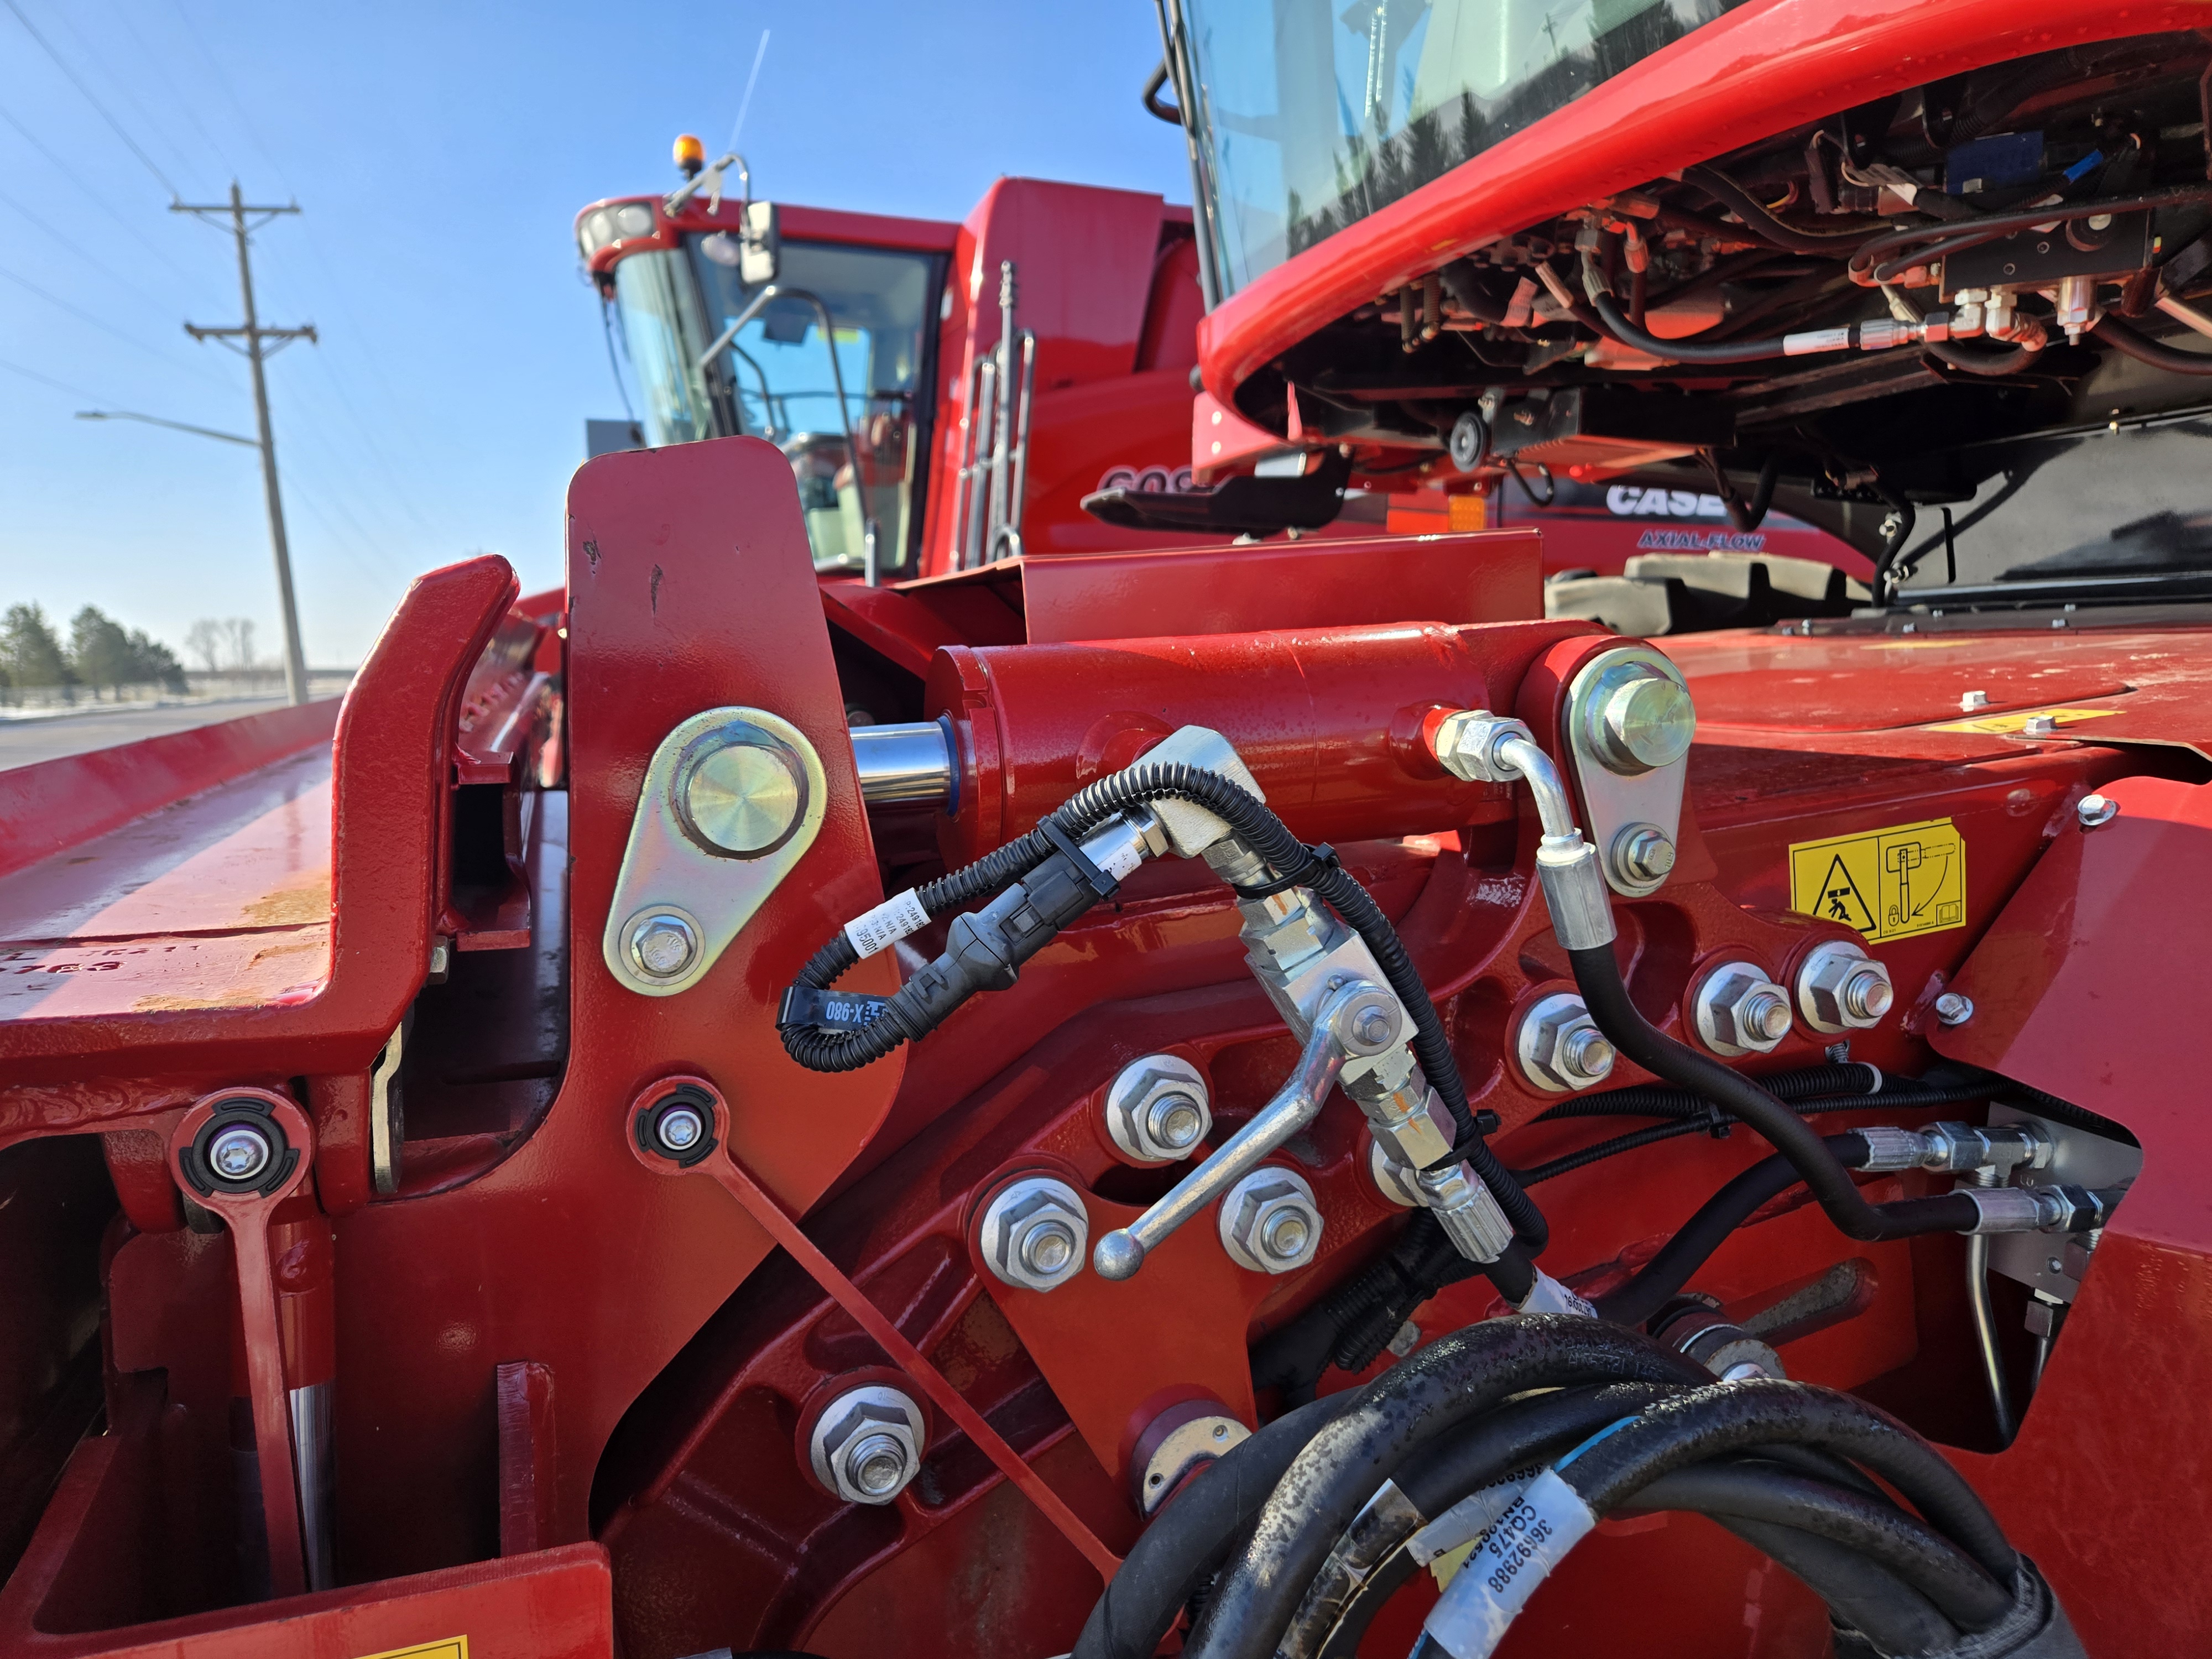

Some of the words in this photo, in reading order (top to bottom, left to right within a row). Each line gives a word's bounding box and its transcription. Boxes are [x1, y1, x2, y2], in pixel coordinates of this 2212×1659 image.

[1637, 529, 1766, 551] AXIAL-FLOW
[826, 1001, 864, 1023] X-980
[1488, 1505, 1536, 1559] CQ475
[1488, 1519, 1552, 1593] 36692988
